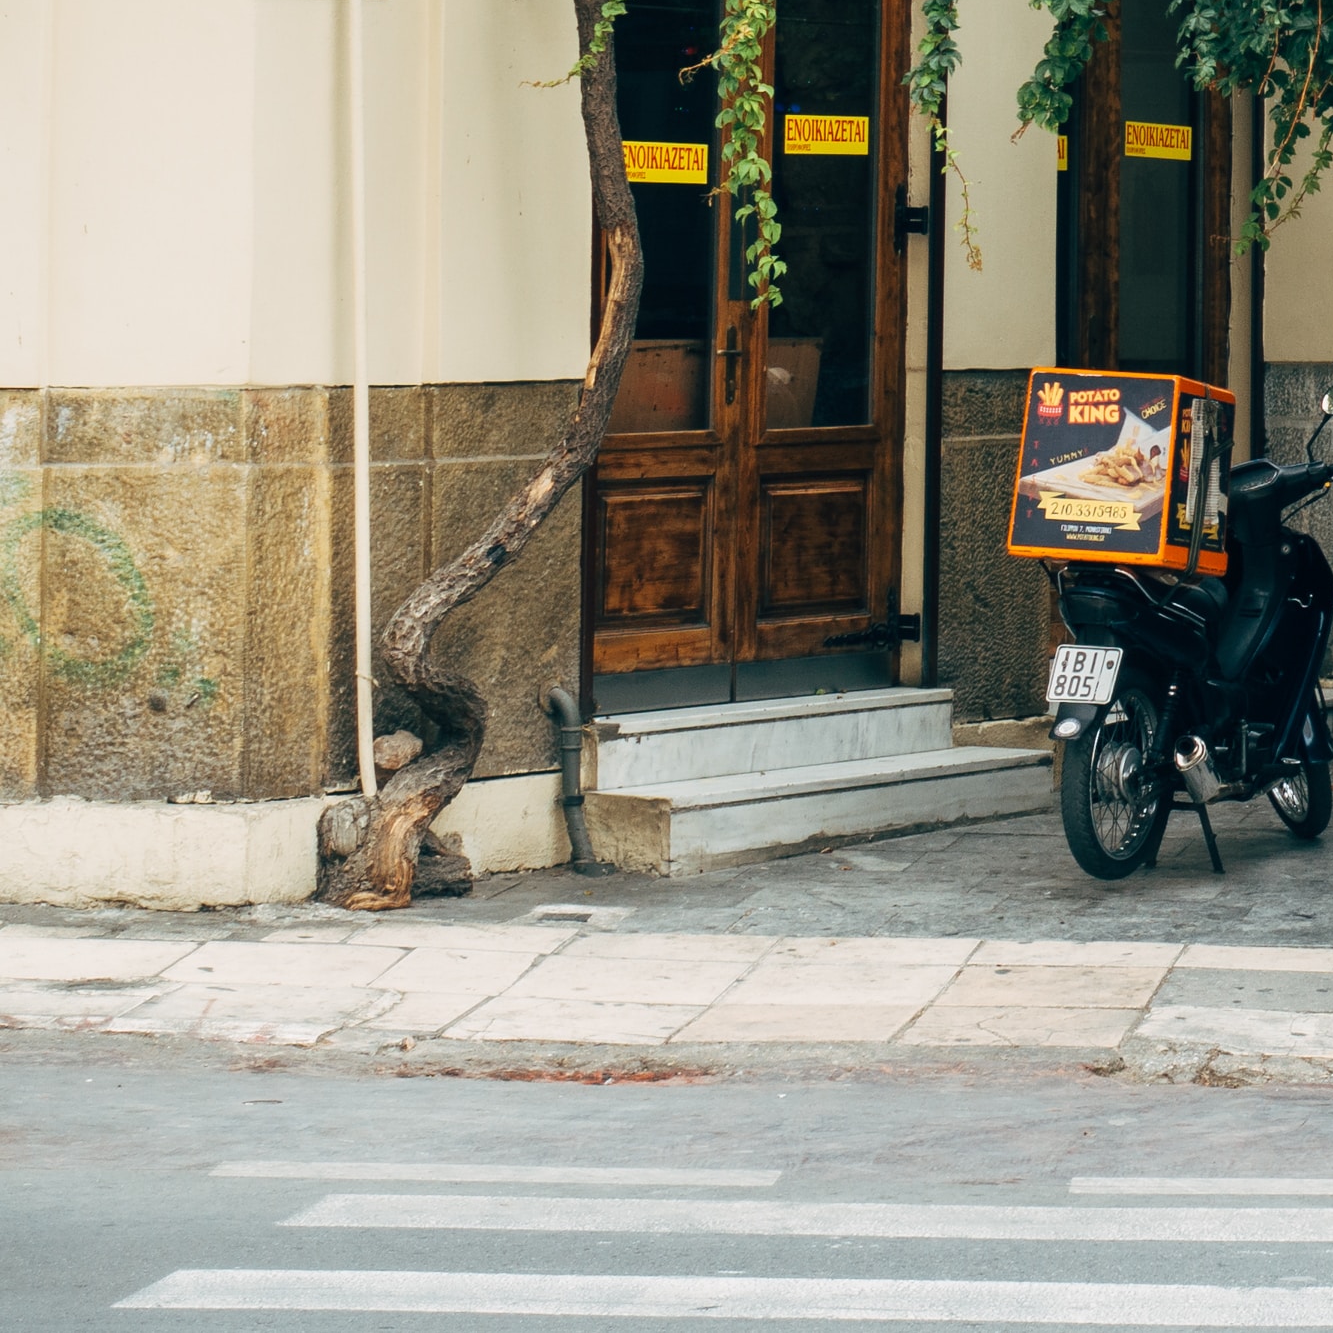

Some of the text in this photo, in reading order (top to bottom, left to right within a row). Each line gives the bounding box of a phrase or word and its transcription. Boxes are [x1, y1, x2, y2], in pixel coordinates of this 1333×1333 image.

[787, 118, 866, 143] ΕΝΟΙΚΙΑΖΕΤΑΙ
[1126, 124, 1190, 150] ΕΝΟΙΚΙΑΖΕΤΑΙ
[1068, 388, 1122, 403] POTATO
[1068, 404, 1121, 424] KING
[1141, 399, 1167, 420] CHOICE
[1050, 501, 1128, 519] 210.3315985
[1054, 675, 1095, 697] 805
